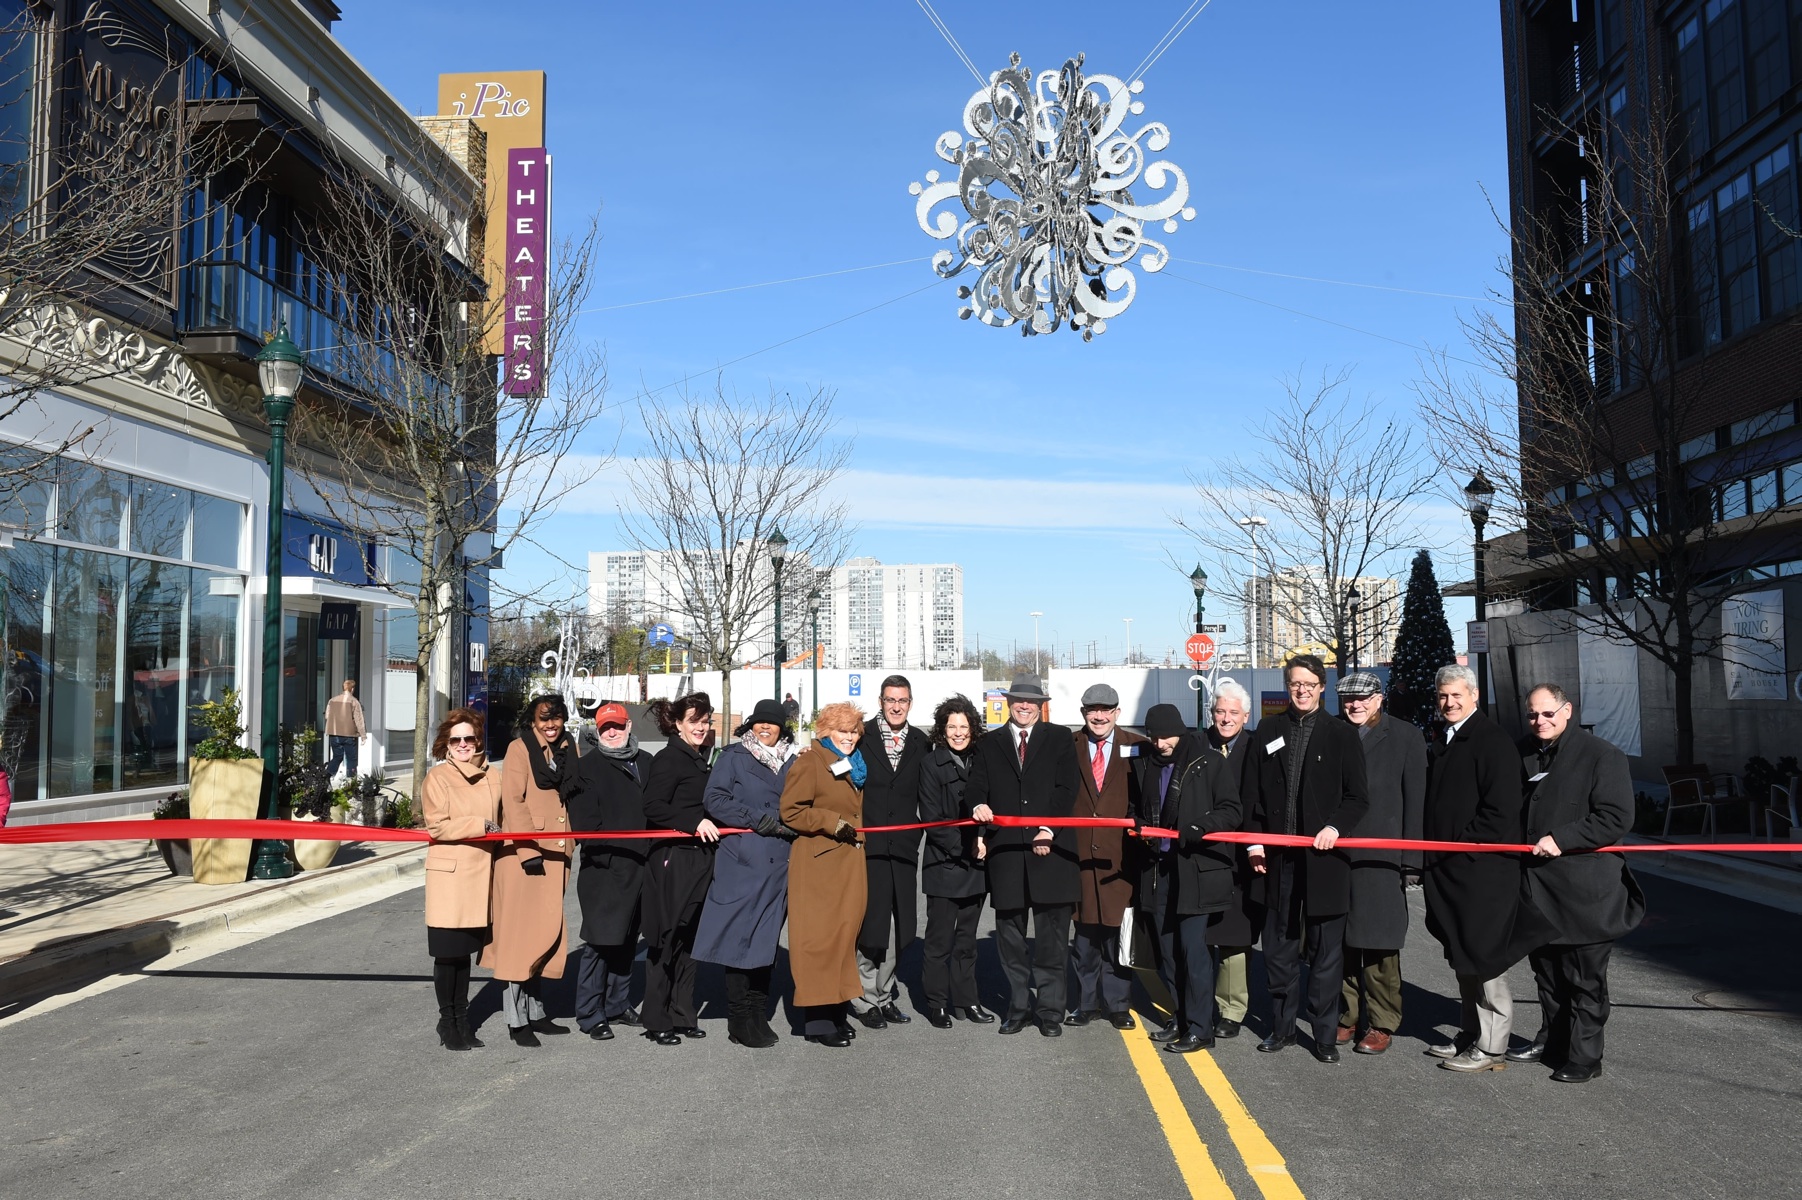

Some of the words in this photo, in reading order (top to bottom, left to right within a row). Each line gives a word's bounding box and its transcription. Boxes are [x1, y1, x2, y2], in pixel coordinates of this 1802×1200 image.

[452, 82, 530, 118] iPic
[513, 160, 536, 381] THEATERS
[310, 534, 337, 574] GAP
[1736, 602, 1762, 618] NOW
[326, 613, 348, 630] GAP
[656, 626, 668, 640] P
[1188, 643, 1213, 654] STOP
[1751, 679, 1778, 687] HOUSE
[994, 702, 1002, 711] P
